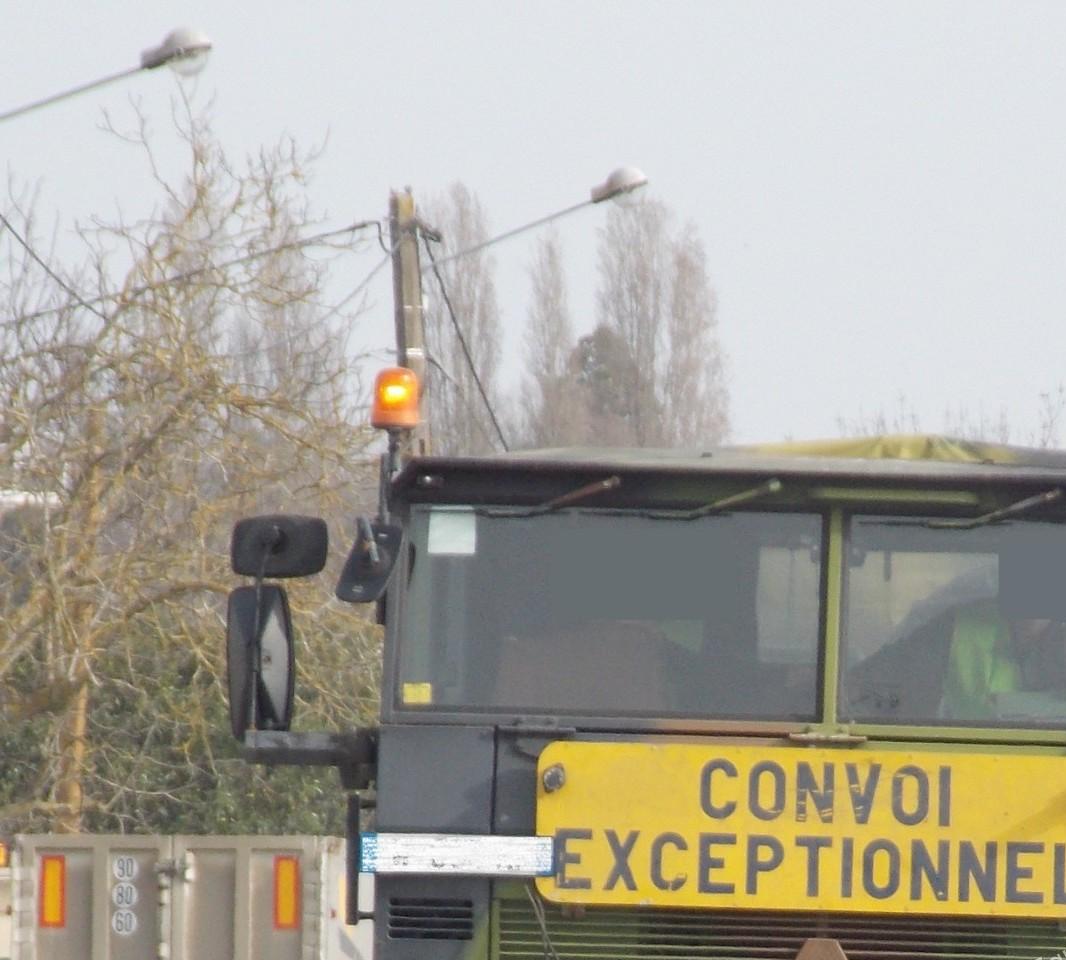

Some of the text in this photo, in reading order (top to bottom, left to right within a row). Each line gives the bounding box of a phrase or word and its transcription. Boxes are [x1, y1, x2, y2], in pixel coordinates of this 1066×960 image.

[700, 757, 952, 827] CONVOI
[117, 857, 134, 878] 90
[116, 885, 133, 905] 80
[115, 911, 133, 932] 60
